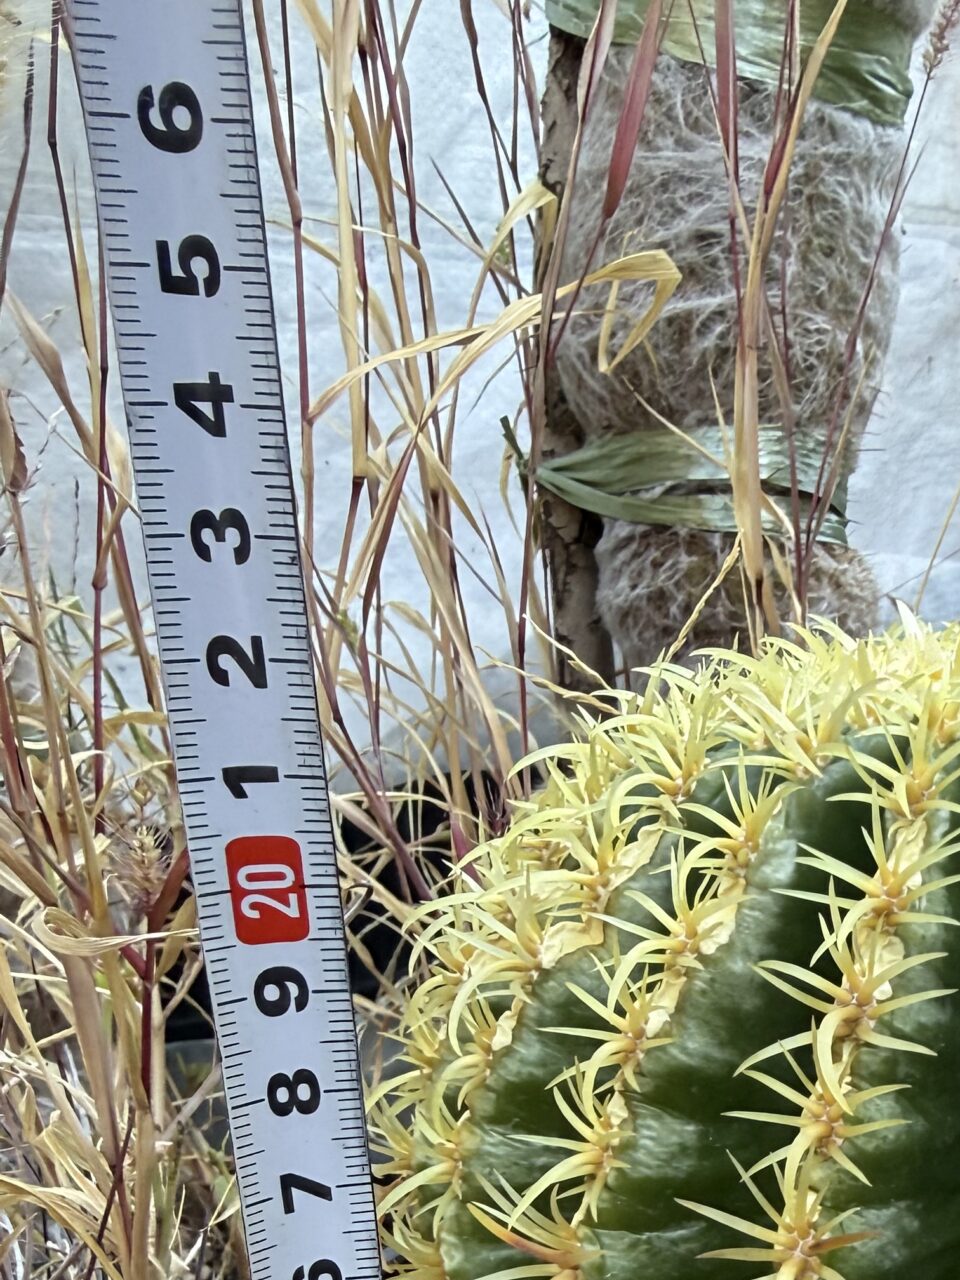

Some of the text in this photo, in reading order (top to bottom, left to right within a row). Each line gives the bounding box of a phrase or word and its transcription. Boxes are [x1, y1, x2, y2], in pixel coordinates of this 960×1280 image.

[137, 82, 203, 153] 6
[156, 235, 220, 297] 5
[173, 372, 234, 437] 4
[190, 508, 250, 565] 3
[206, 635, 267, 689] 2
[222, 766, 279, 799] 1
[236, 864, 300, 919] 20
[254, 966, 309, 1017] 9
[267, 1069, 320, 1116] 8
[280, 1173, 332, 1214] 7
